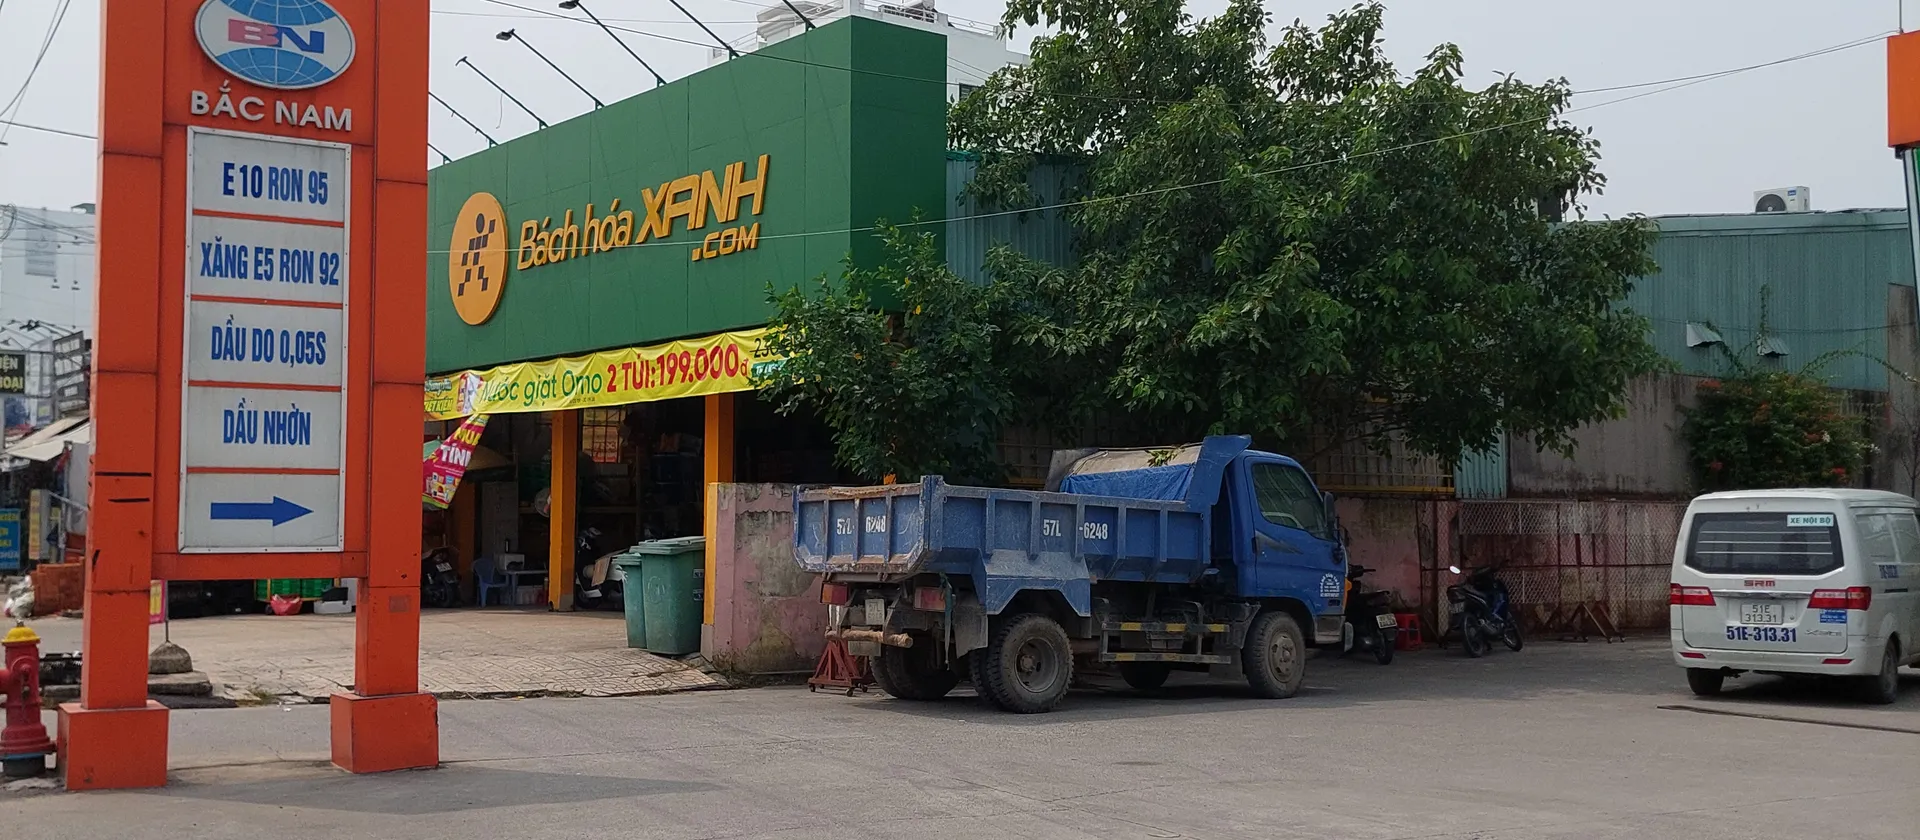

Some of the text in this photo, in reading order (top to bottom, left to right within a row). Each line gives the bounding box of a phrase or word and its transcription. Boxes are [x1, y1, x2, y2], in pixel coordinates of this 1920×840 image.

[228, 19, 324, 54] BN
[191, 79, 352, 131] BẮC NAM
[268, 166, 303, 202] RON
[308, 170, 328, 205] 95
[517, 154, 770, 270] Bách hóa XANH
[200, 236, 340, 286] XĂNG E5 RON 92
[691, 222, 760, 261] .COM
[211, 314, 326, 368] DẦU DO 0,05S
[524, 374, 557, 407] giặt
[562, 370, 602, 397] Omo
[607, 364, 617, 392] 2
[223, 397, 311, 445] DẦU NHỜN
[865, 515, 886, 533] 6248
[1043, 519, 1061, 537] 57L
[1745, 613, 1777, 623] 313.31
[1752, 604, 1770, 613] 51E
[1726, 625, 1797, 642] 51E-313.31
